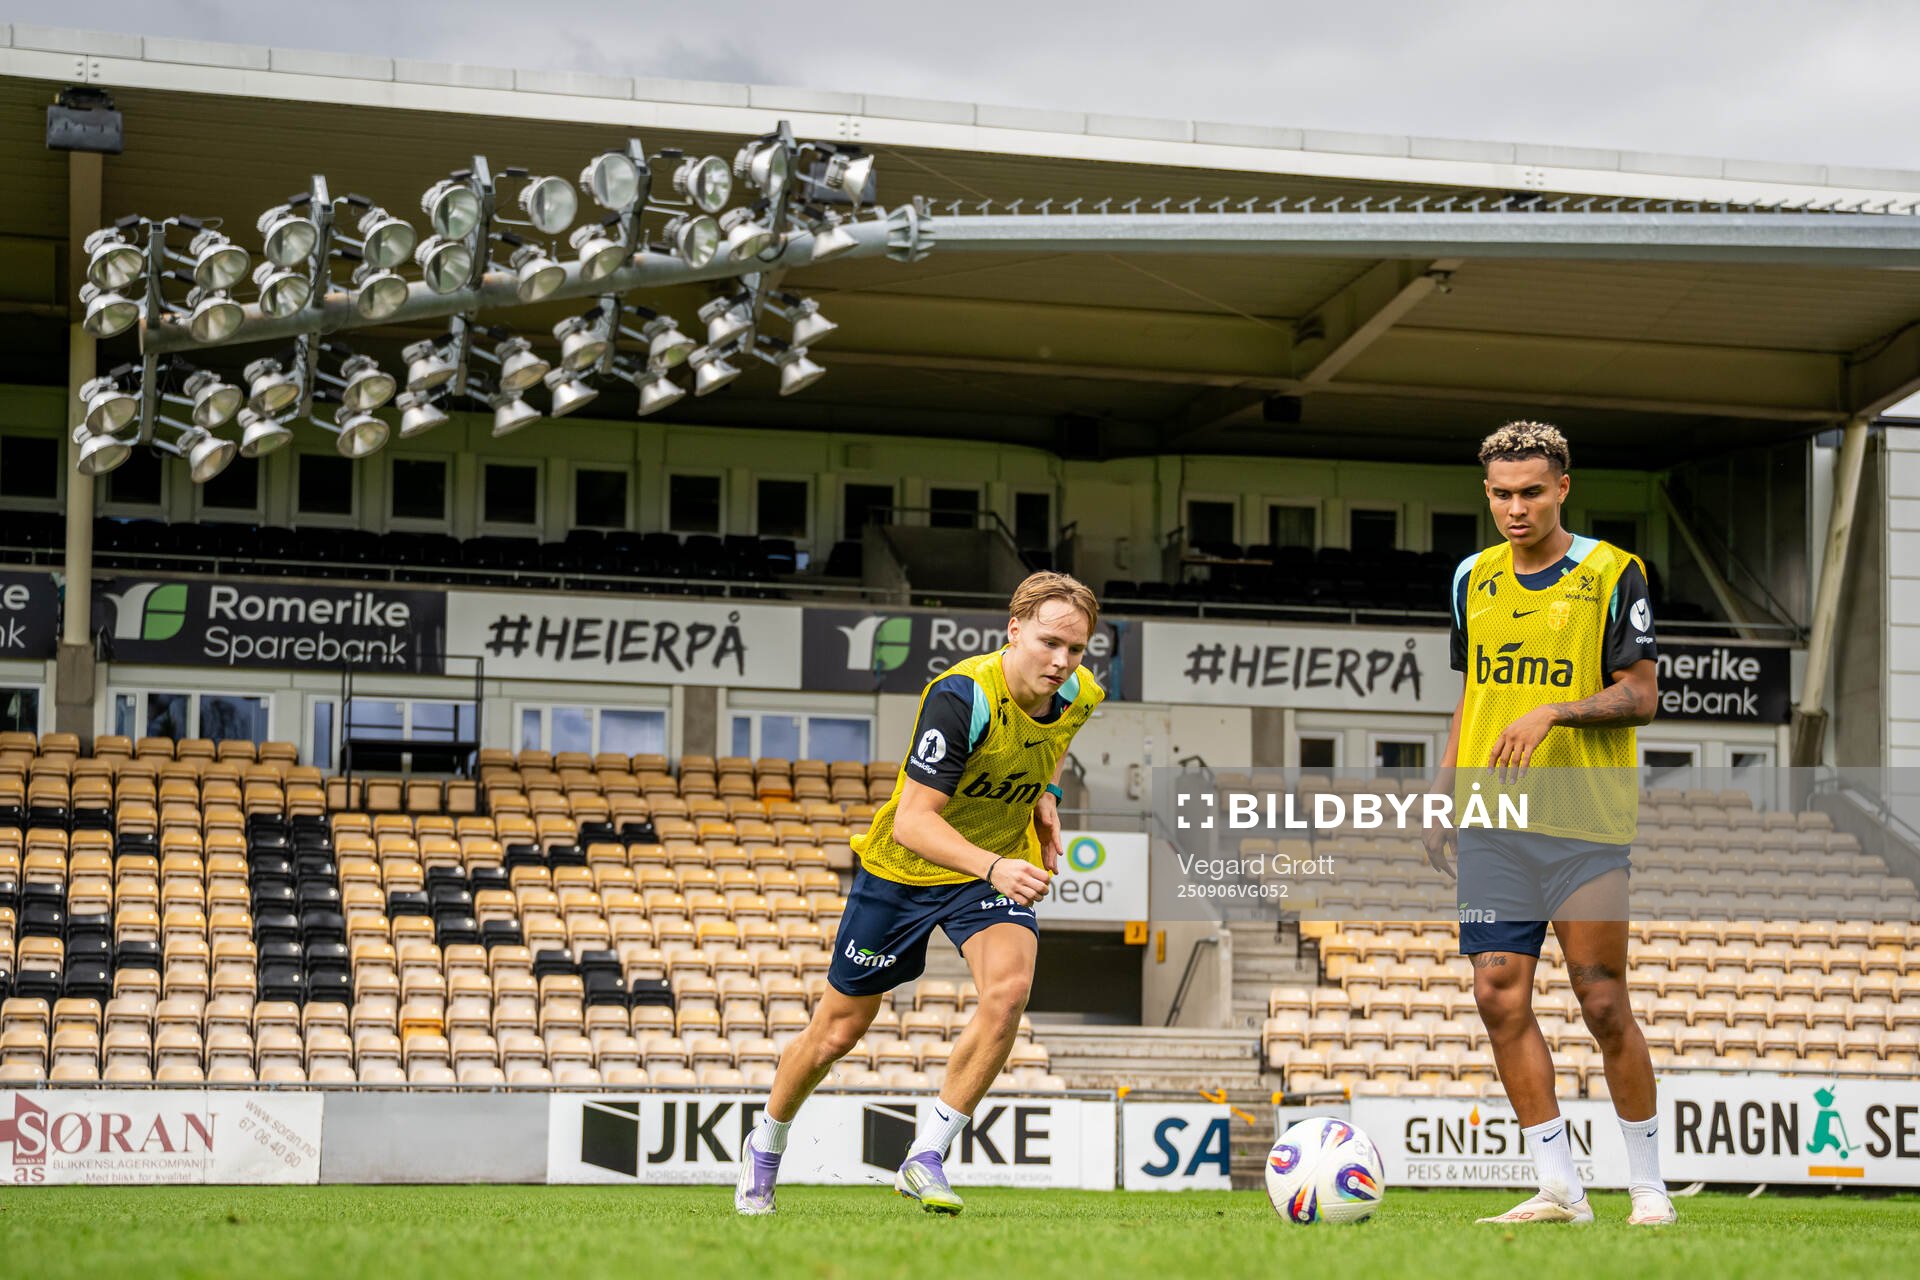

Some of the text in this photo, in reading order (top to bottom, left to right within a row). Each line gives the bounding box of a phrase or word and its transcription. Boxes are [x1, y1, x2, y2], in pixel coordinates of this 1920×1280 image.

[0, 584, 30, 611] e
[208, 585, 410, 627] Romerike
[203, 626, 407, 665] Sparebank
[485, 610, 748, 676] #HEIERPÅ
[930, 619, 1109, 656] Rome
[1183, 637, 1423, 701] #HEIERPÅ
[16, 1111, 216, 1156] SØRAN
[239, 1117, 301, 1168] 67 06 40 60
[942, 1105, 1051, 1165] KE
[1141, 1117, 1230, 1177] SA
[1674, 1100, 1920, 1158] RAGN SE
[14, 1167, 45, 1182] as
[53, 1159, 216, 1170] BLIKKENSLAGERKOMPANIET
[1408, 1164, 1442, 1180] PEIS
[1447, 1165, 1458, 1180] &
